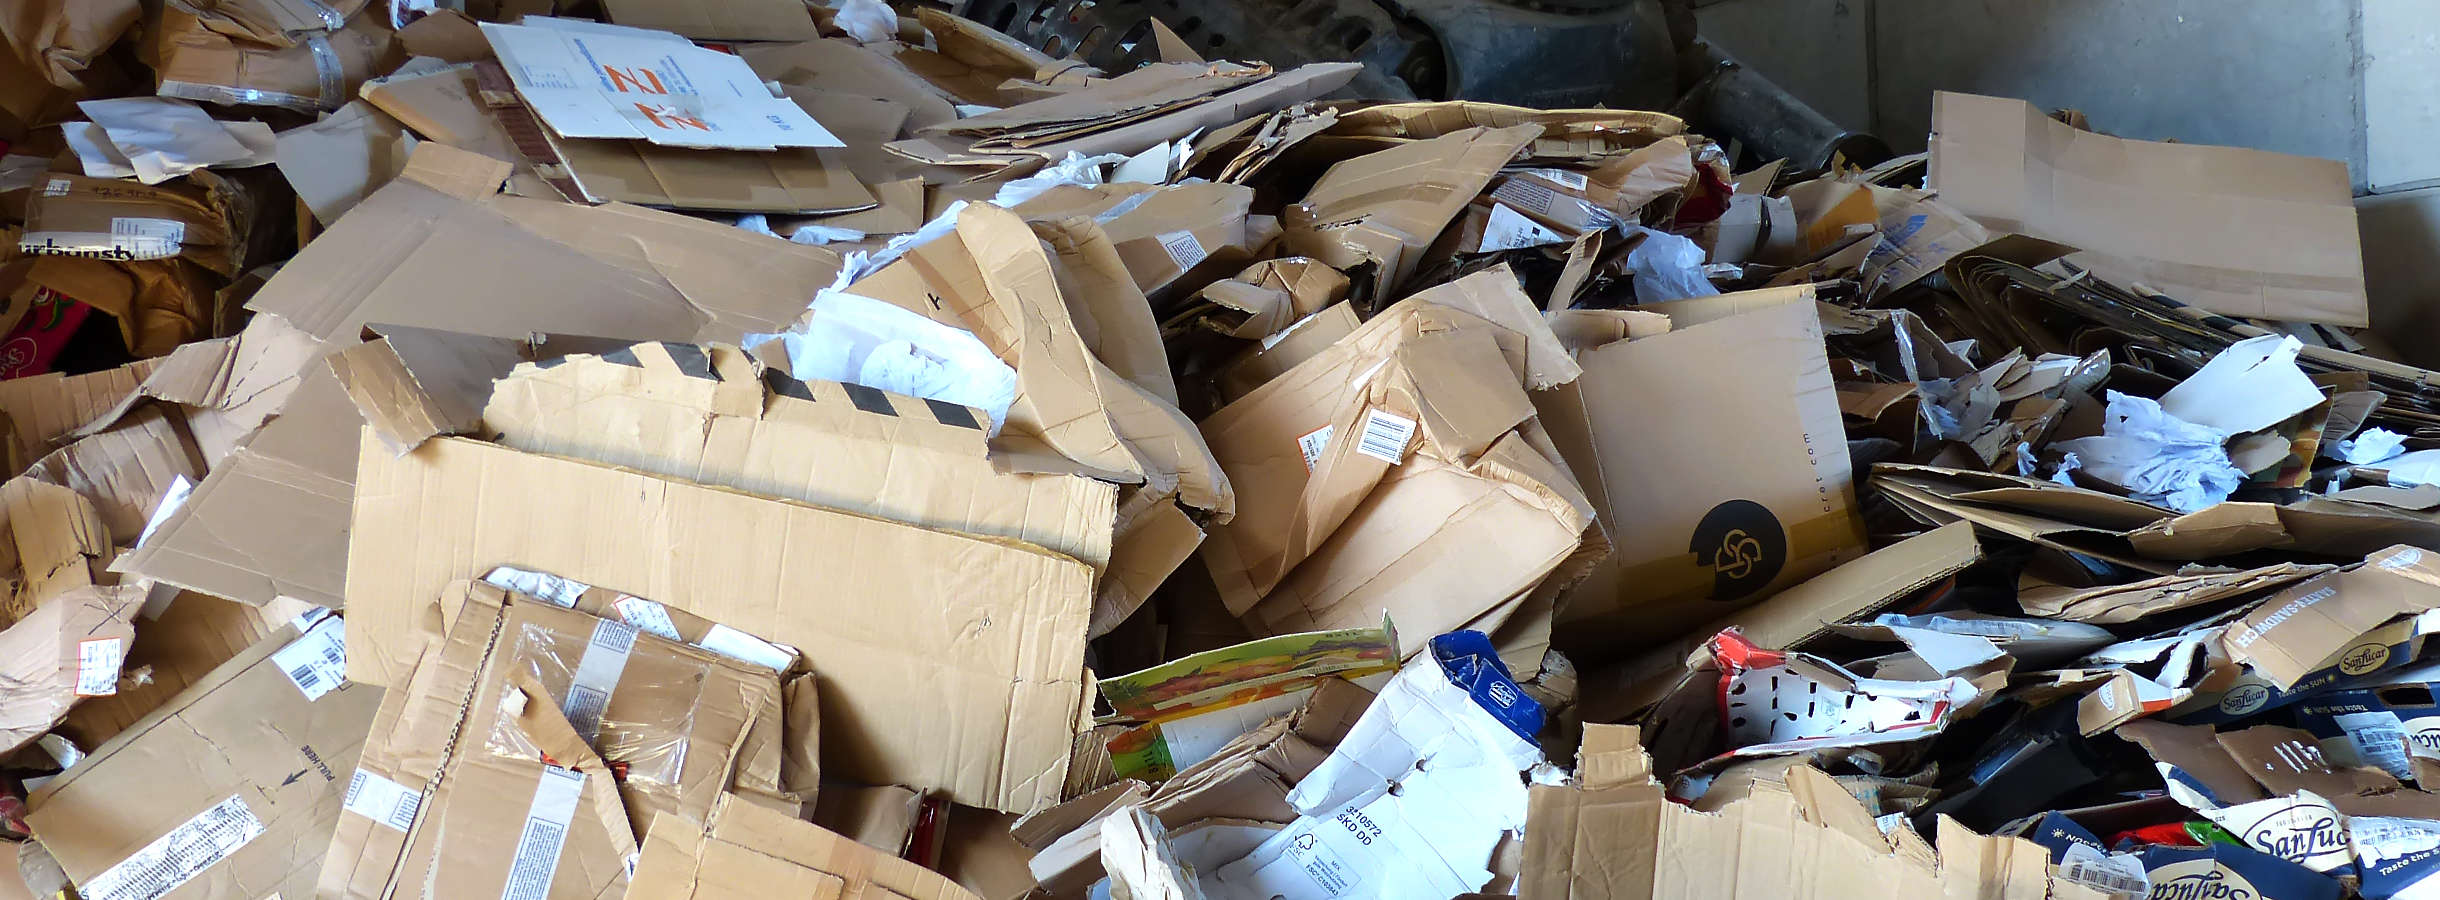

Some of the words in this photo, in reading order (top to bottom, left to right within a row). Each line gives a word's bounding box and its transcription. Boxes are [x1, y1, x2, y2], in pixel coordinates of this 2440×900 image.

[2343, 648, 2386, 672] SanLucar
[2223, 688, 2266, 713] SanLucar
[317, 762, 335, 781] PULL
[1336, 813, 1358, 832] SKD
[1356, 830, 1372, 846] DD
[2379, 859, 2410, 876] Taste
[2410, 852, 2431, 862] the
